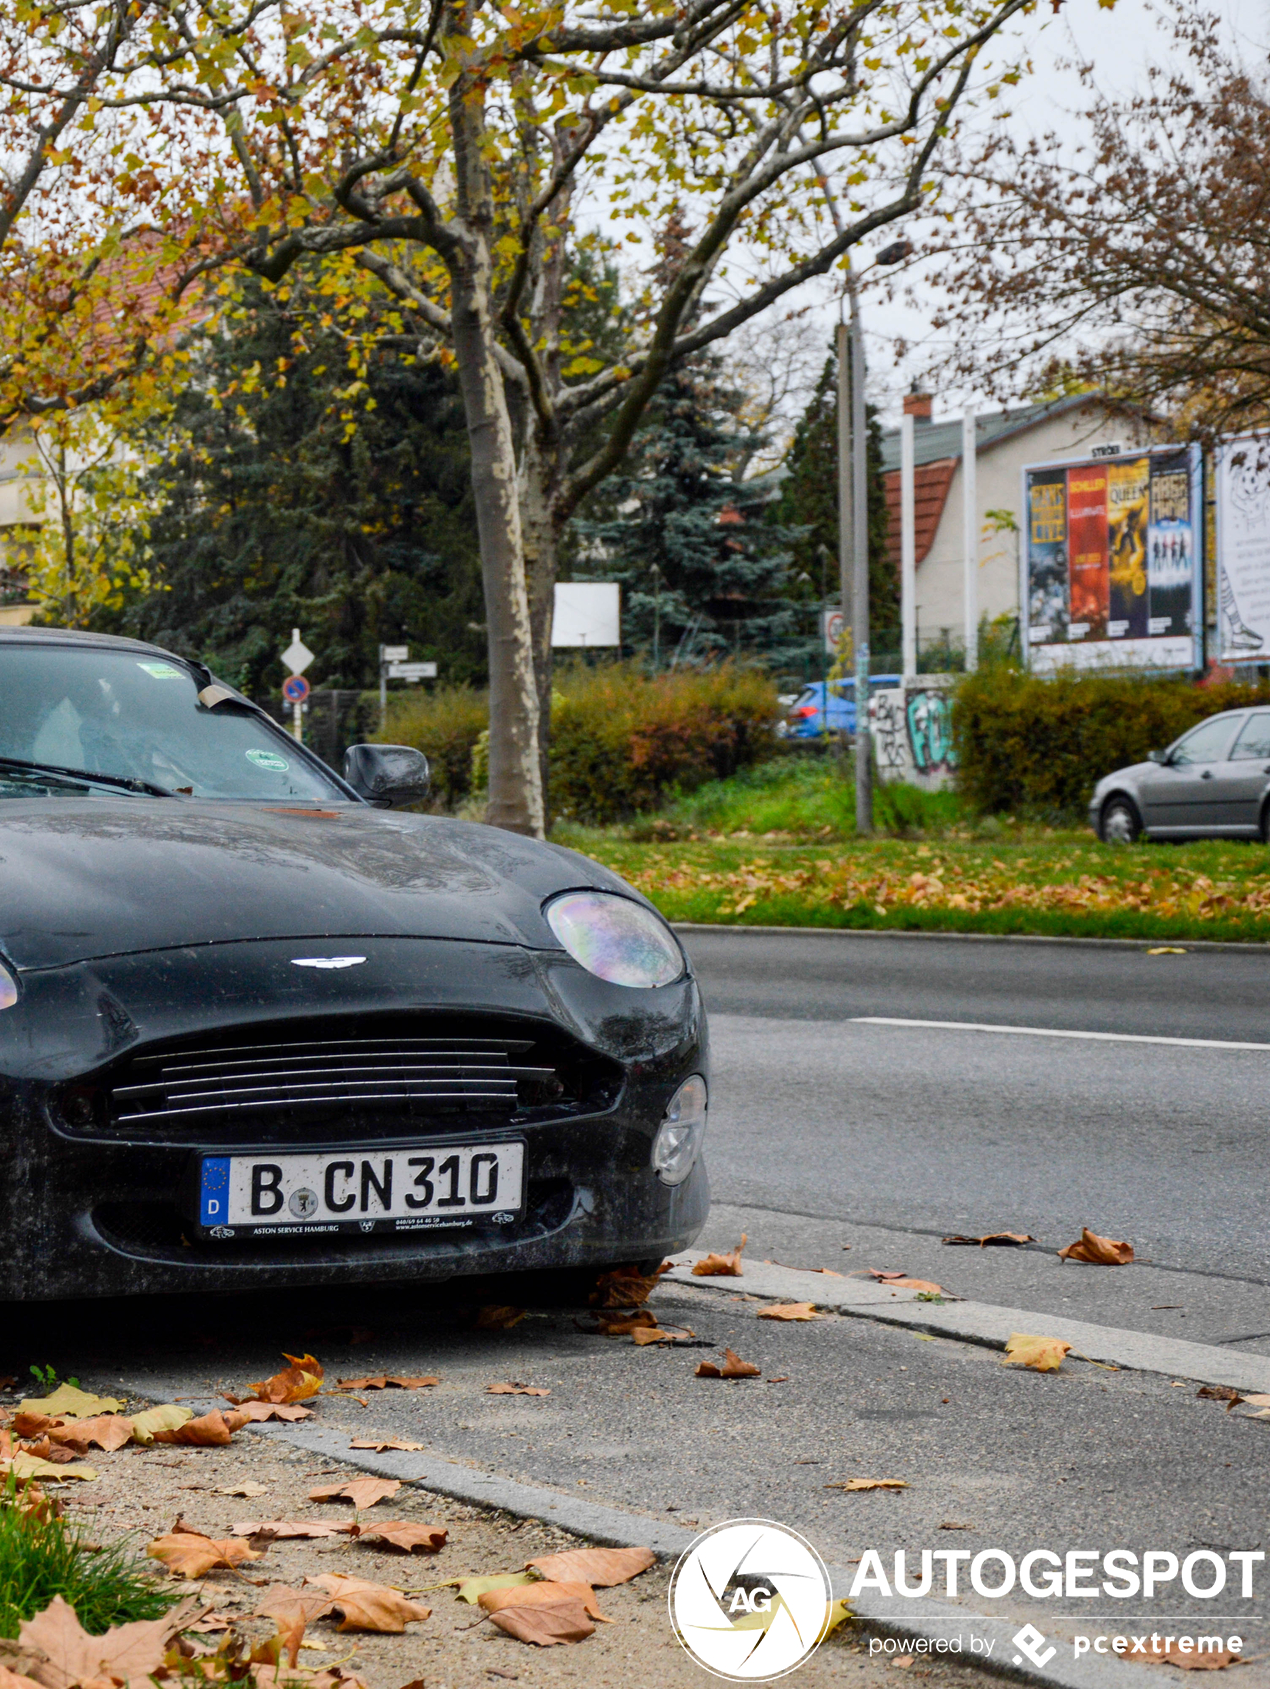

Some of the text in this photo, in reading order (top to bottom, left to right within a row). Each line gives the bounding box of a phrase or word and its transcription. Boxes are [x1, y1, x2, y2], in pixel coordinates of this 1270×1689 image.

[251, 1152, 499, 1216] B CN 310
[207, 1200, 220, 1215] D
[253, 1224, 339, 1235] ASTON SERVICE HAMBURG
